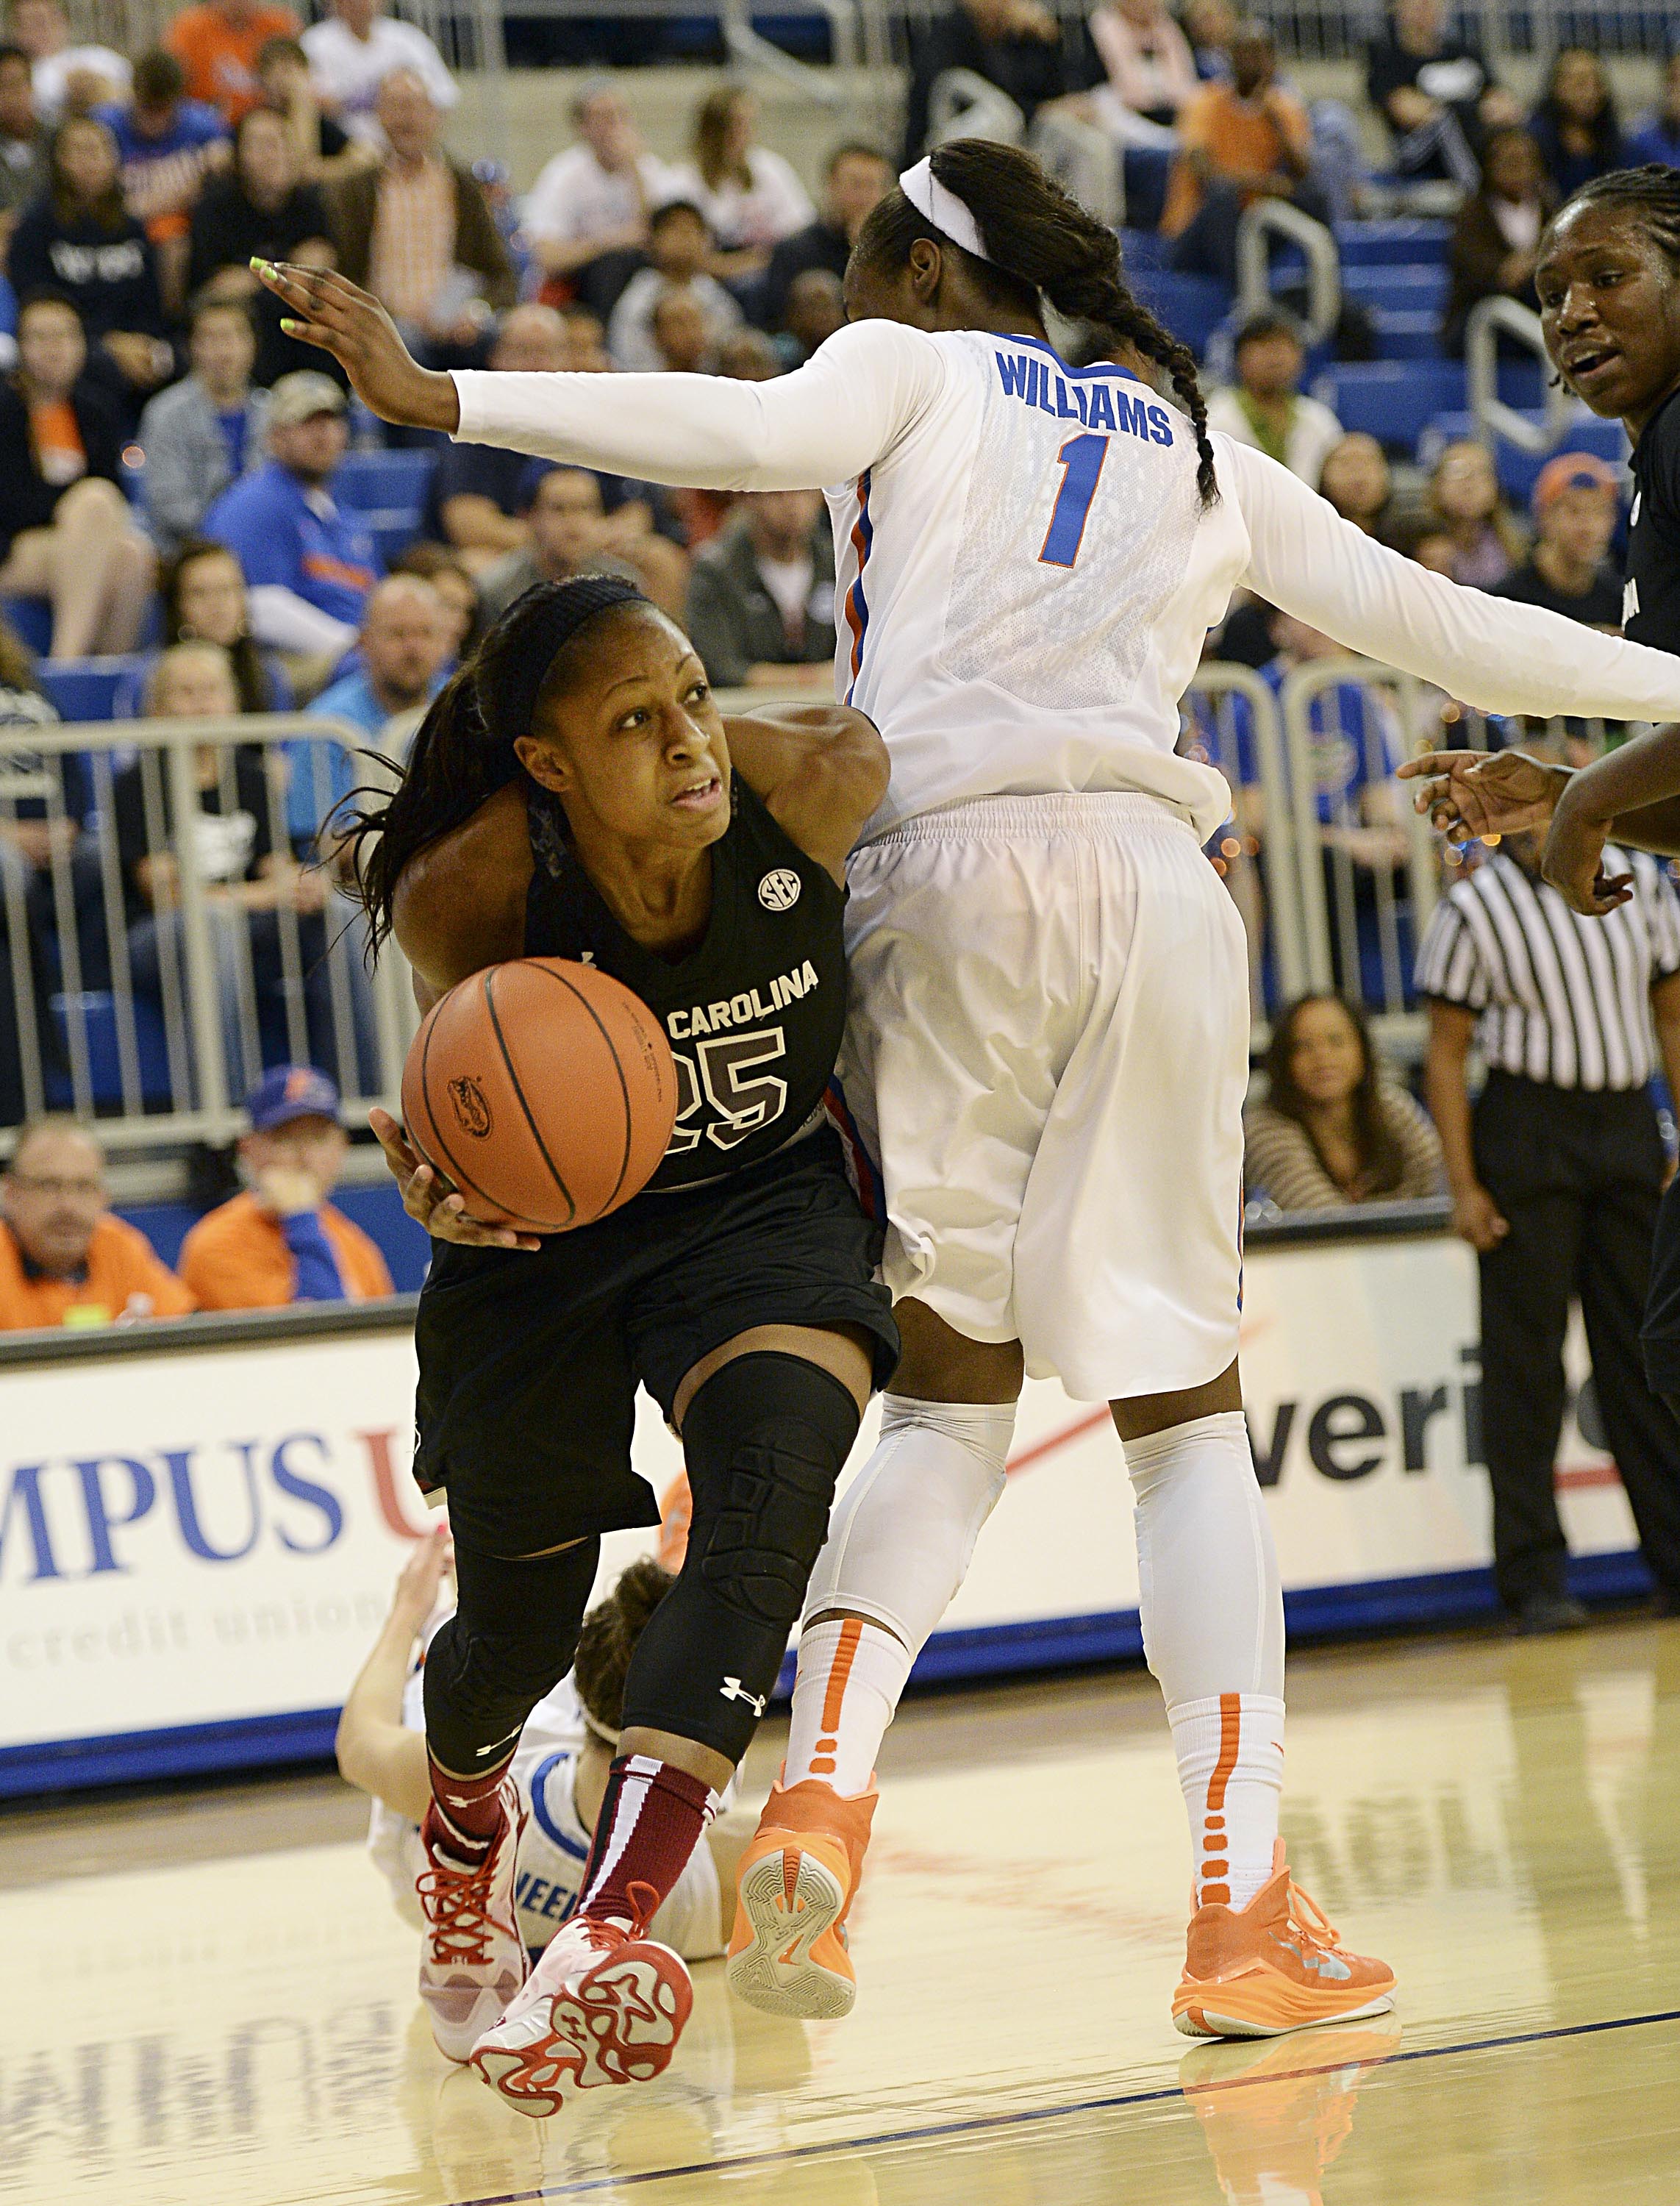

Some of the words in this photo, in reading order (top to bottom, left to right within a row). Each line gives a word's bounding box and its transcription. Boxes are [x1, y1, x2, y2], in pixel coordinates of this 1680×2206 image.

[995, 351, 1174, 447] WILLIAMS
[1037, 432, 1111, 569] 1
[759, 869, 800, 910] SEC
[667, 960, 820, 1040] CAROLINA
[1243, 1344, 1613, 1488] veri
